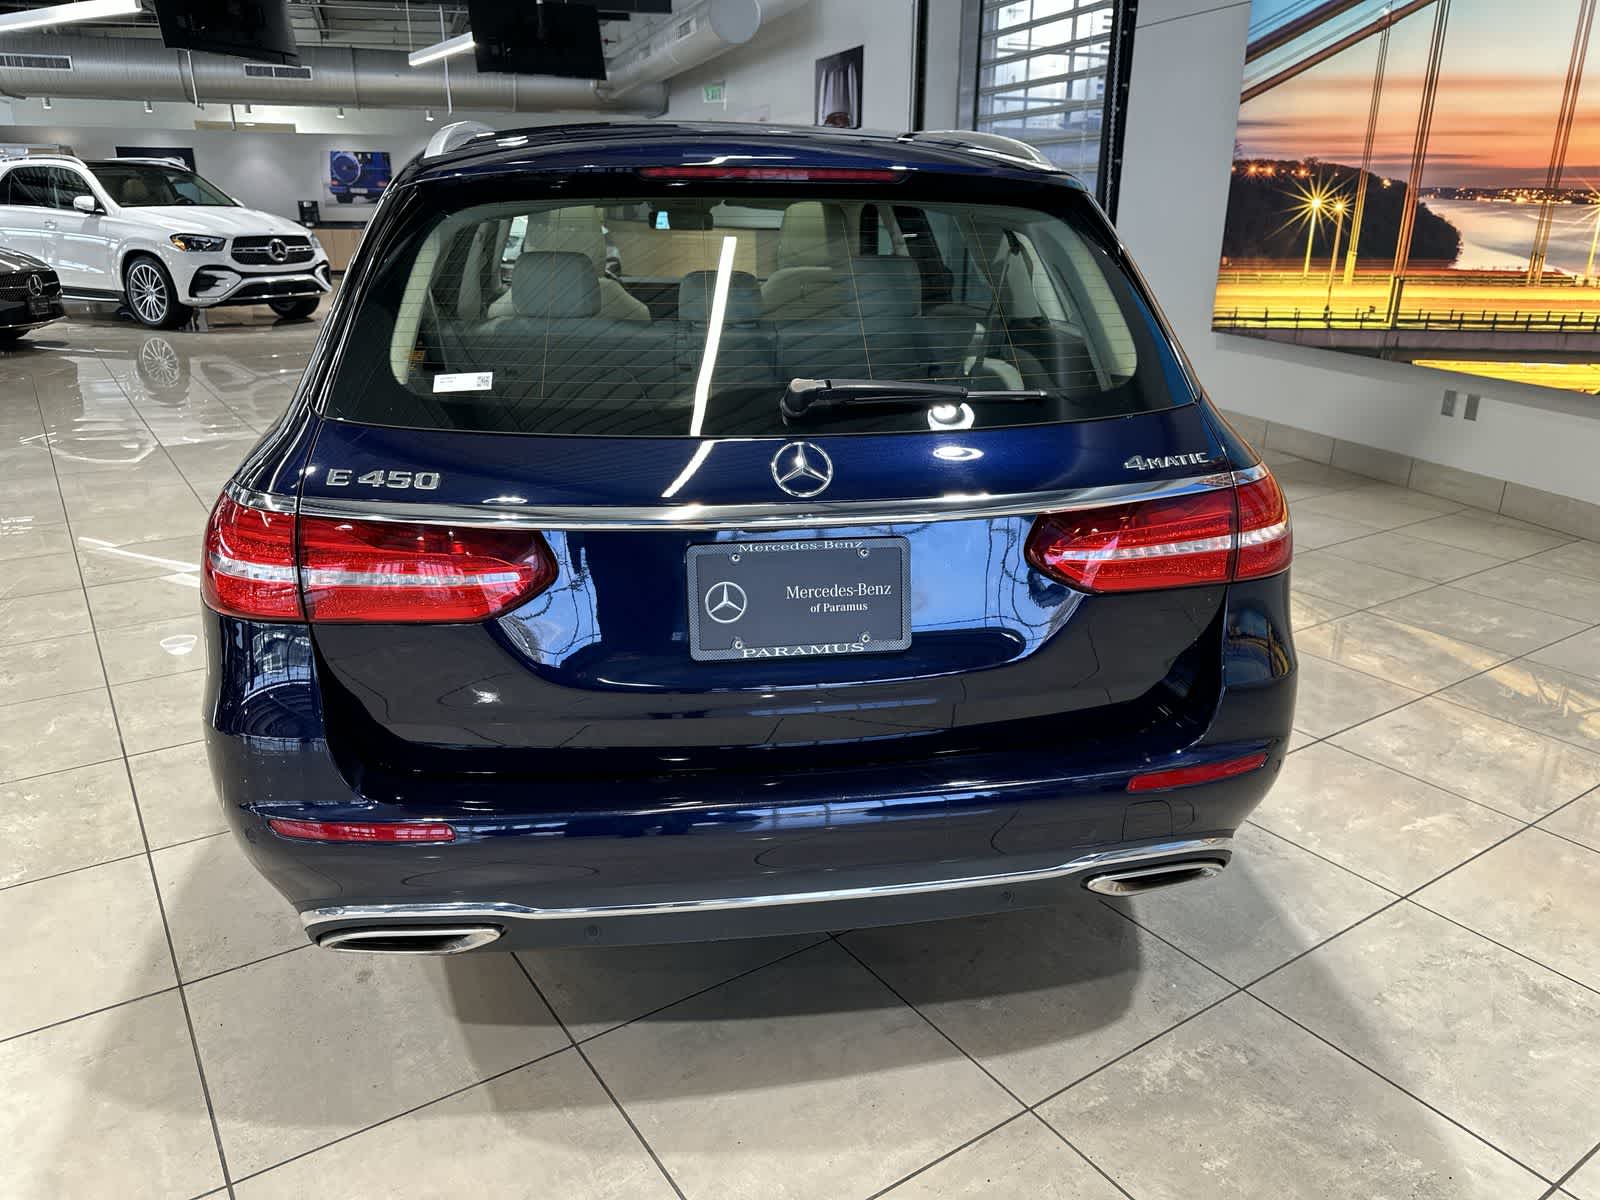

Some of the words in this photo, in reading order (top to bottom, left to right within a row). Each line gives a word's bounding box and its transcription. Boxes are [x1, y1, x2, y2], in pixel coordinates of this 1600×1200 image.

[1123, 452, 1209, 471] 4MATIC
[326, 468, 352, 486] E
[357, 469, 440, 490] 450
[739, 540, 864, 553] Mercedes-Benz
[786, 583, 892, 600] Mercedes-Benz
[810, 602, 821, 613] of
[823, 602, 868, 613] Paramus
[742, 642, 865, 659] PARAMUS
